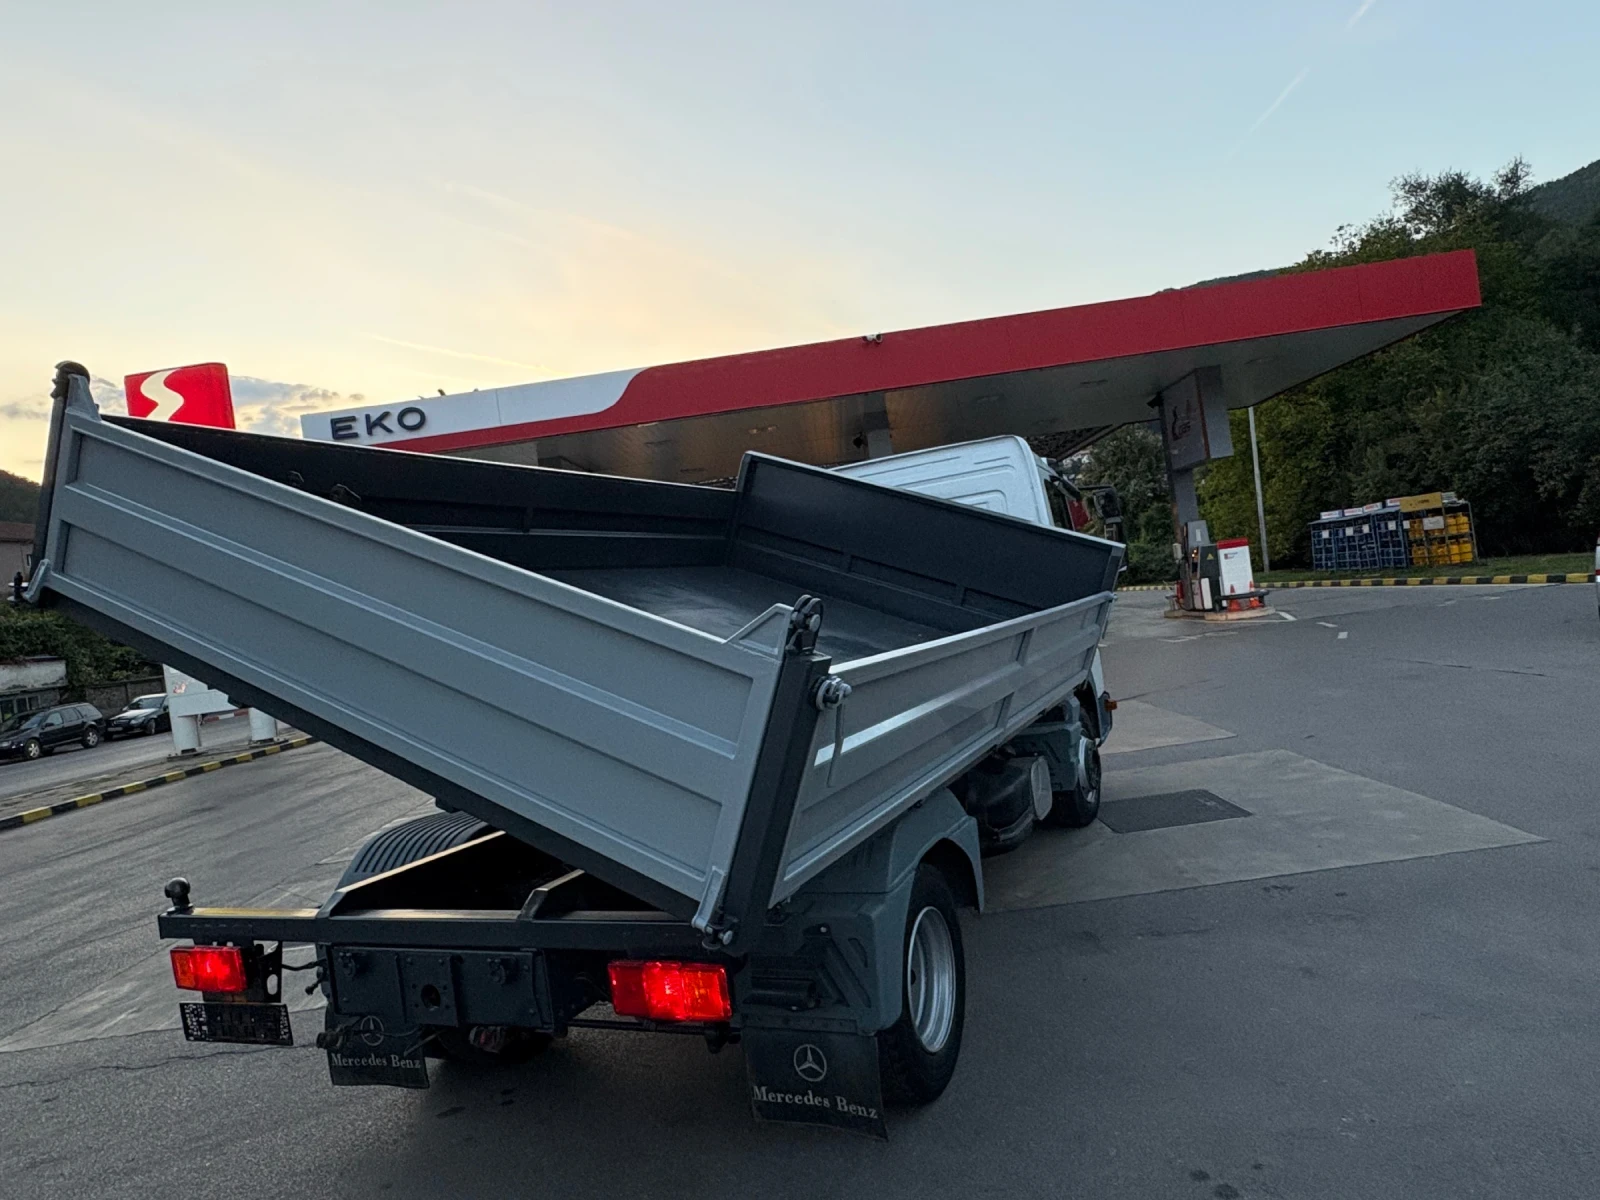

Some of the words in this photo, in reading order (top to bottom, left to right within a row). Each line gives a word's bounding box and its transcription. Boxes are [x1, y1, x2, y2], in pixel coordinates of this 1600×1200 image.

[330, 407, 426, 440] EKO
[331, 1053, 388, 1067] Mercedes
[390, 1054, 421, 1069] Benz
[753, 1085, 831, 1108] Mercedes
[835, 1096, 878, 1119] Benz
